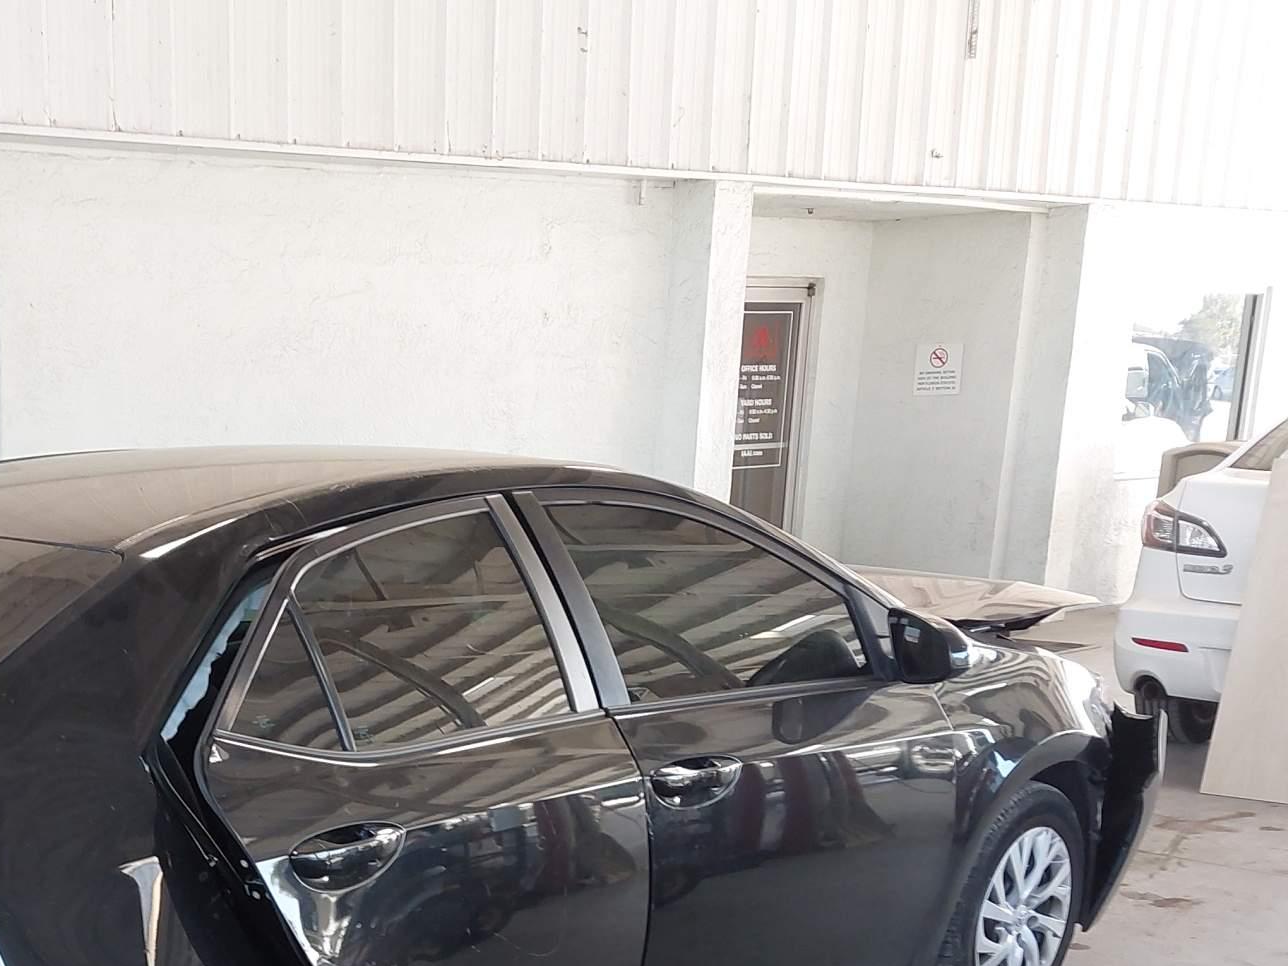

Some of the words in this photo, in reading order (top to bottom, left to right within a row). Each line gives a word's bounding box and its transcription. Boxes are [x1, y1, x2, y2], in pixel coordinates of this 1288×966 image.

[741, 364, 758, 372] OFFICE
[759, 364, 777, 372] HOURS
[754, 398, 772, 406] HOURS
[742, 432, 759, 440] PARTS
[759, 432, 773, 440] SOLD
